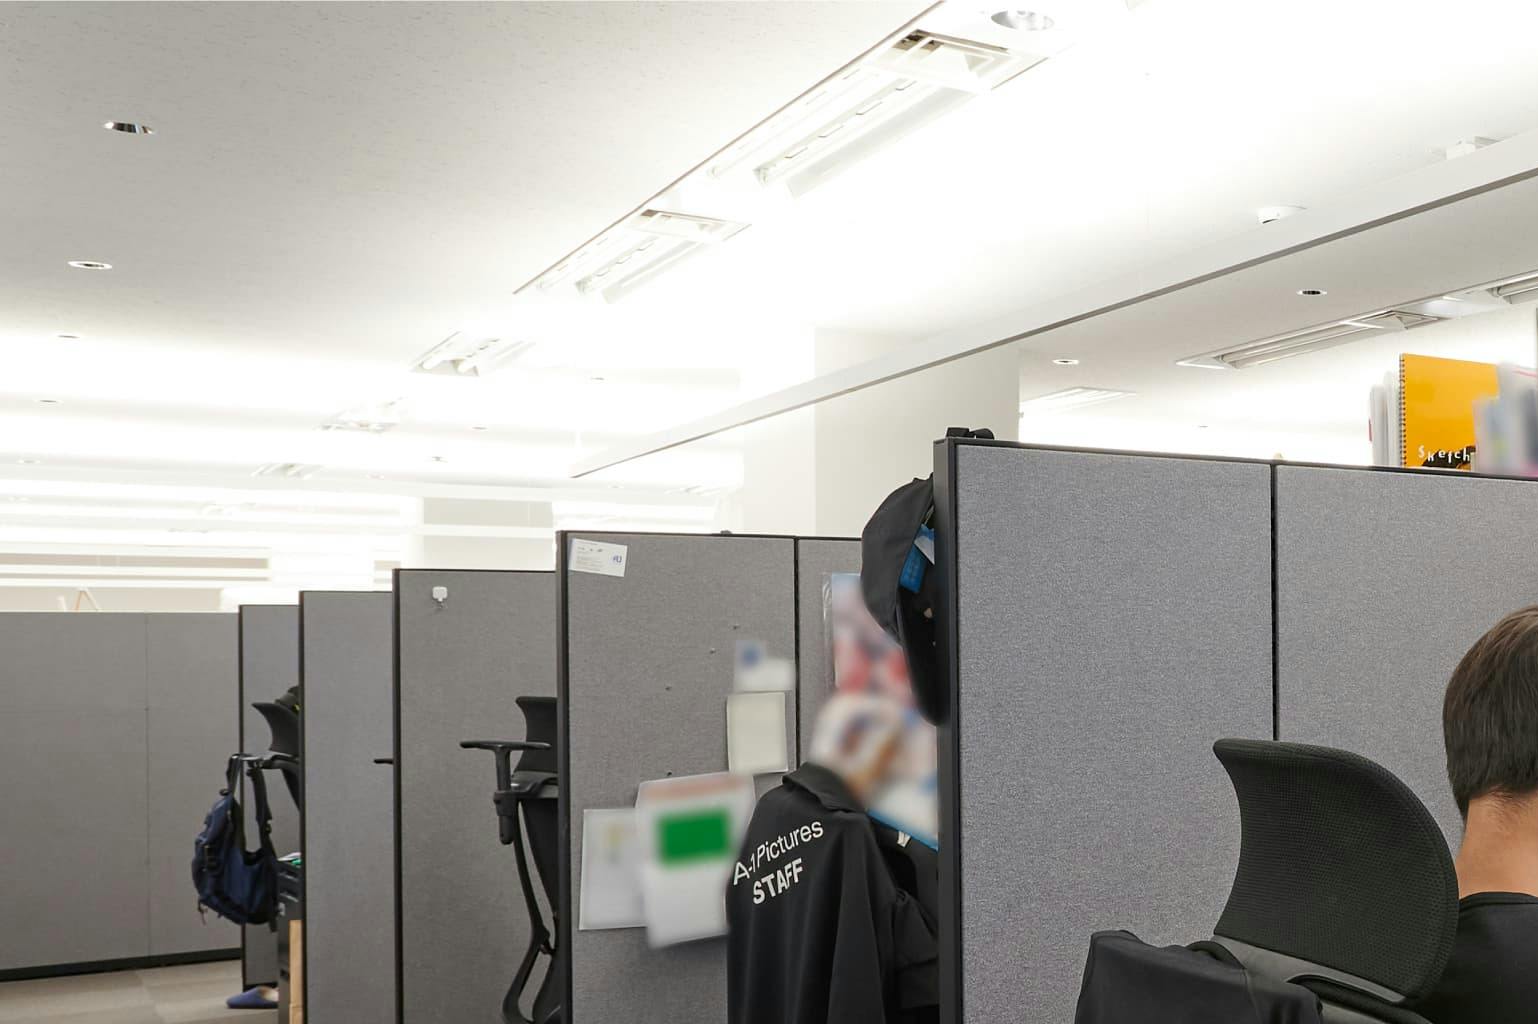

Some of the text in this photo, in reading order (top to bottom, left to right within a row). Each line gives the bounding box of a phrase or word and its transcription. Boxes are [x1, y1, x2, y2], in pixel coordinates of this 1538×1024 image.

[1418, 445, 1470, 463] Sketch
[733, 821, 824, 885] A-1 Pictures
[752, 858, 803, 904] STAFF
